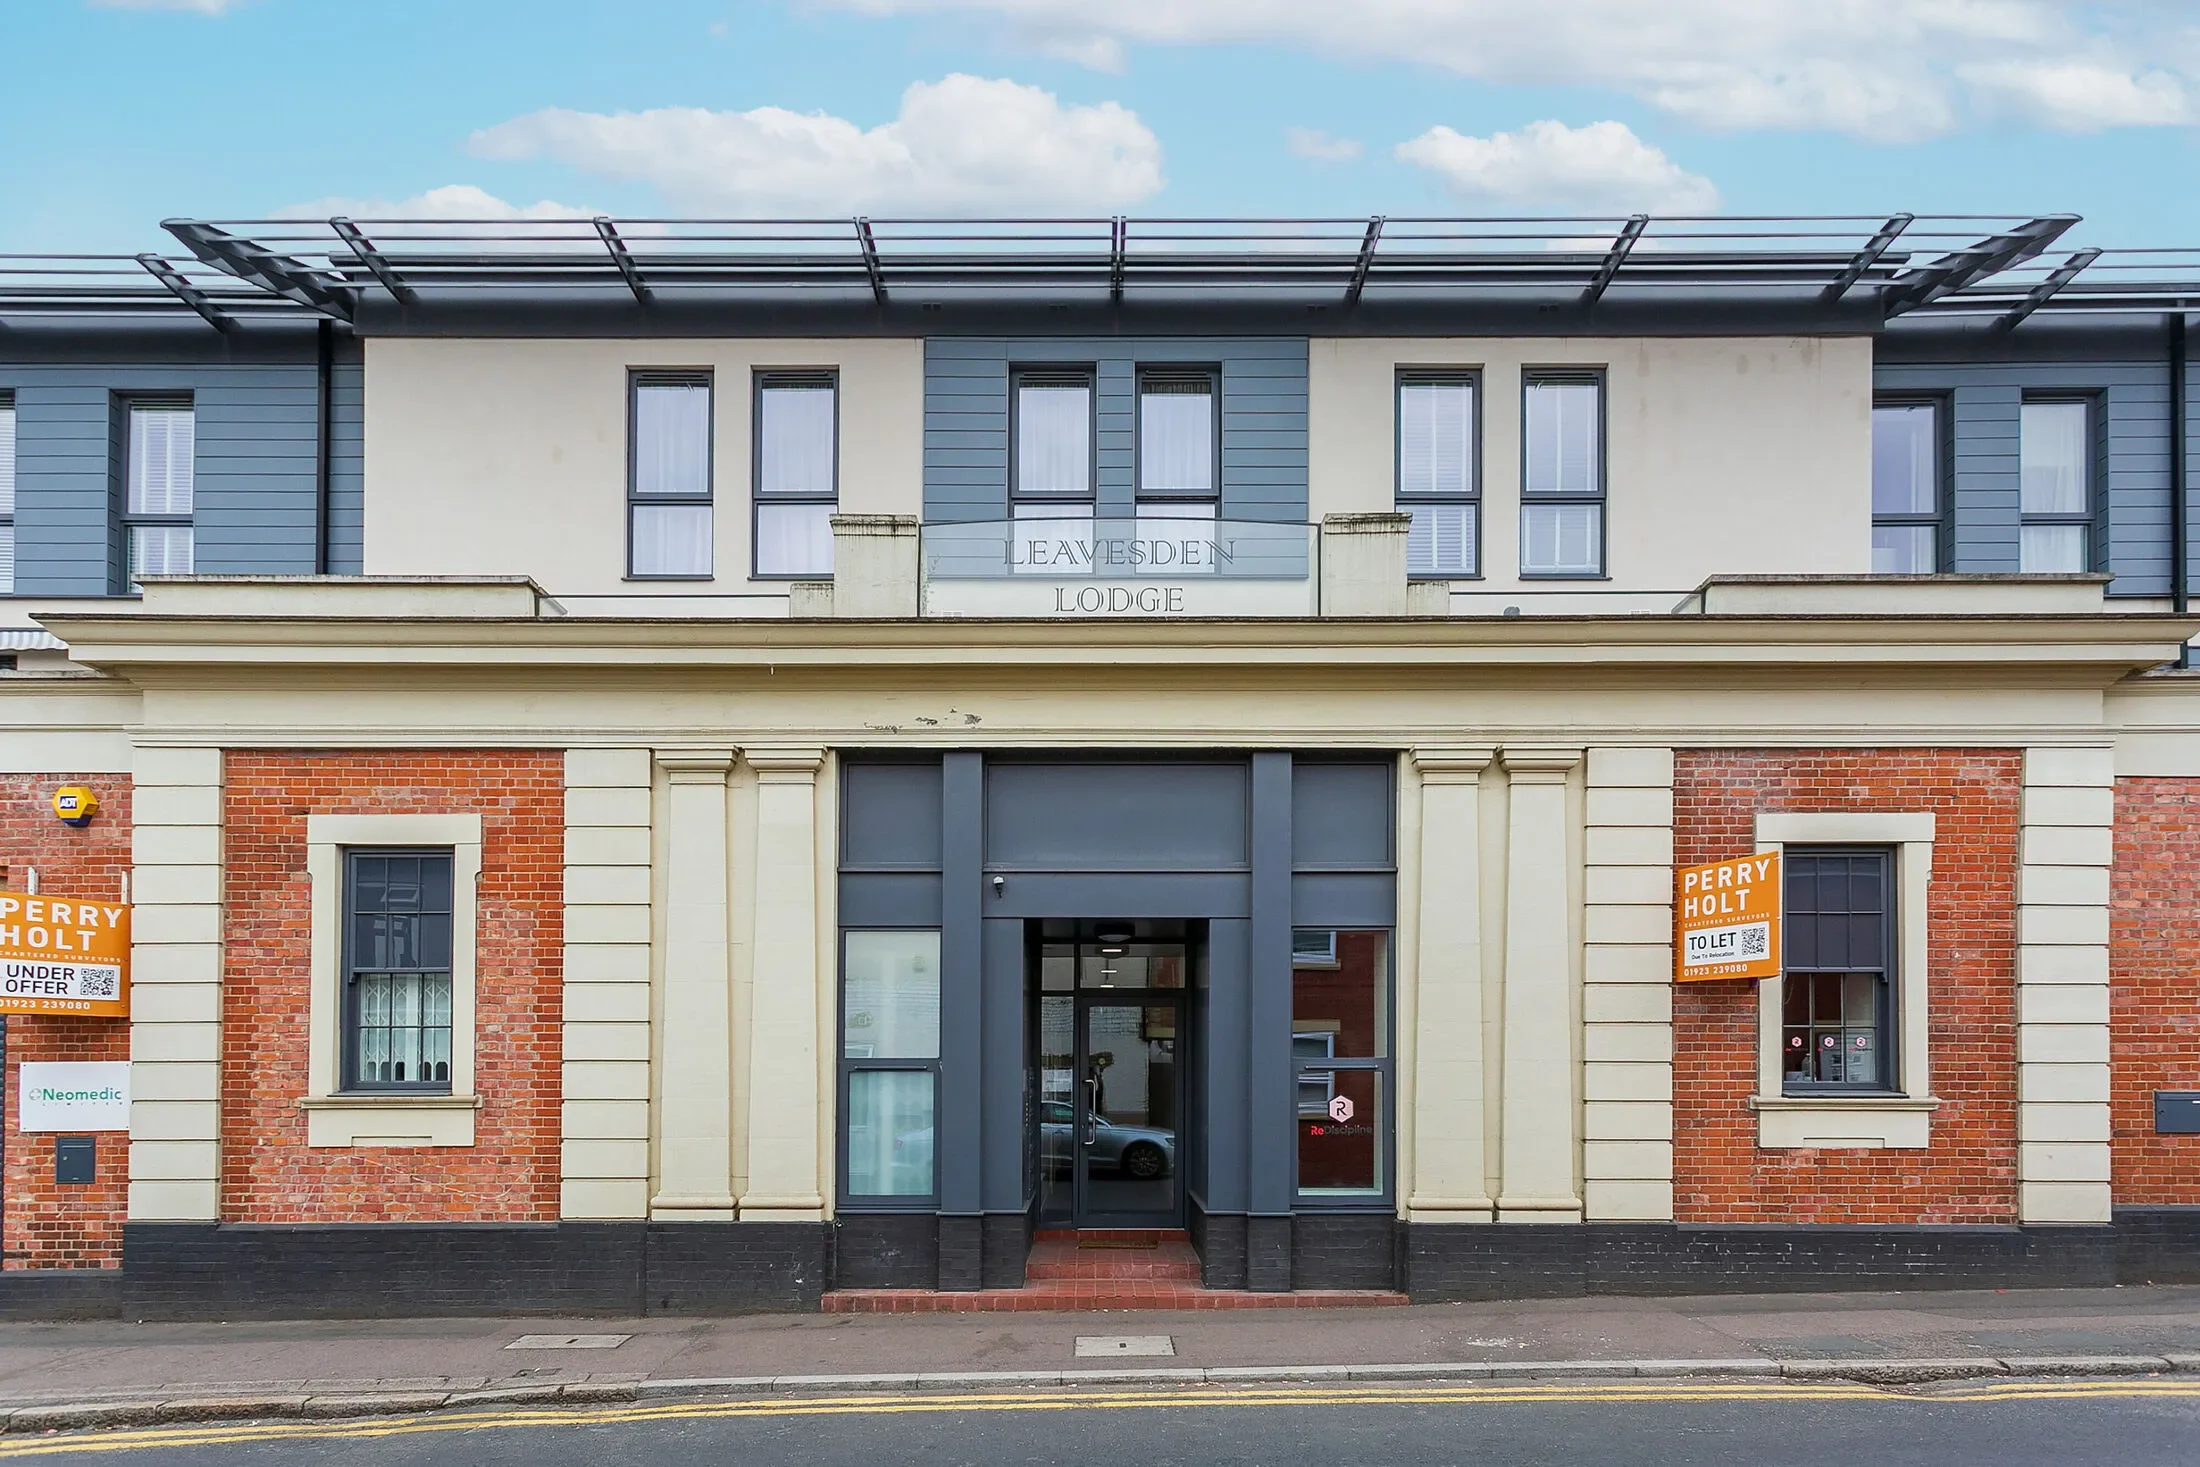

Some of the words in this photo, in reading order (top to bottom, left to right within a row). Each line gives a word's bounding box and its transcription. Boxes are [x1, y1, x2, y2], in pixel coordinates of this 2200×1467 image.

[1002, 539, 1236, 566] LEAVESDEN
[1054, 586, 1185, 613] LODGE
[60, 797, 77, 808] ADT
[1684, 858, 1771, 894] PERRY
[1684, 888, 1750, 919] HOLT
[0, 897, 123, 928] PERRY
[1684, 918, 1723, 928] CHARTERED
[1727, 912, 1770, 923] SURVEYORS
[0, 923, 97, 951] HOLT
[1689, 935, 1707, 951] TO
[1711, 932, 1737, 949] LET
[64, 954, 121, 963] SURVEYORS
[1709, 951, 1735, 959] Relocation
[6, 964, 75, 981] UNDER
[1684, 967, 1710, 977] 01923
[1713, 963, 1748, 974] 239080
[5, 979, 69, 995] OFFER
[42, 1000, 91, 1010] 239080
[42, 1087, 122, 1101] Neomedic
